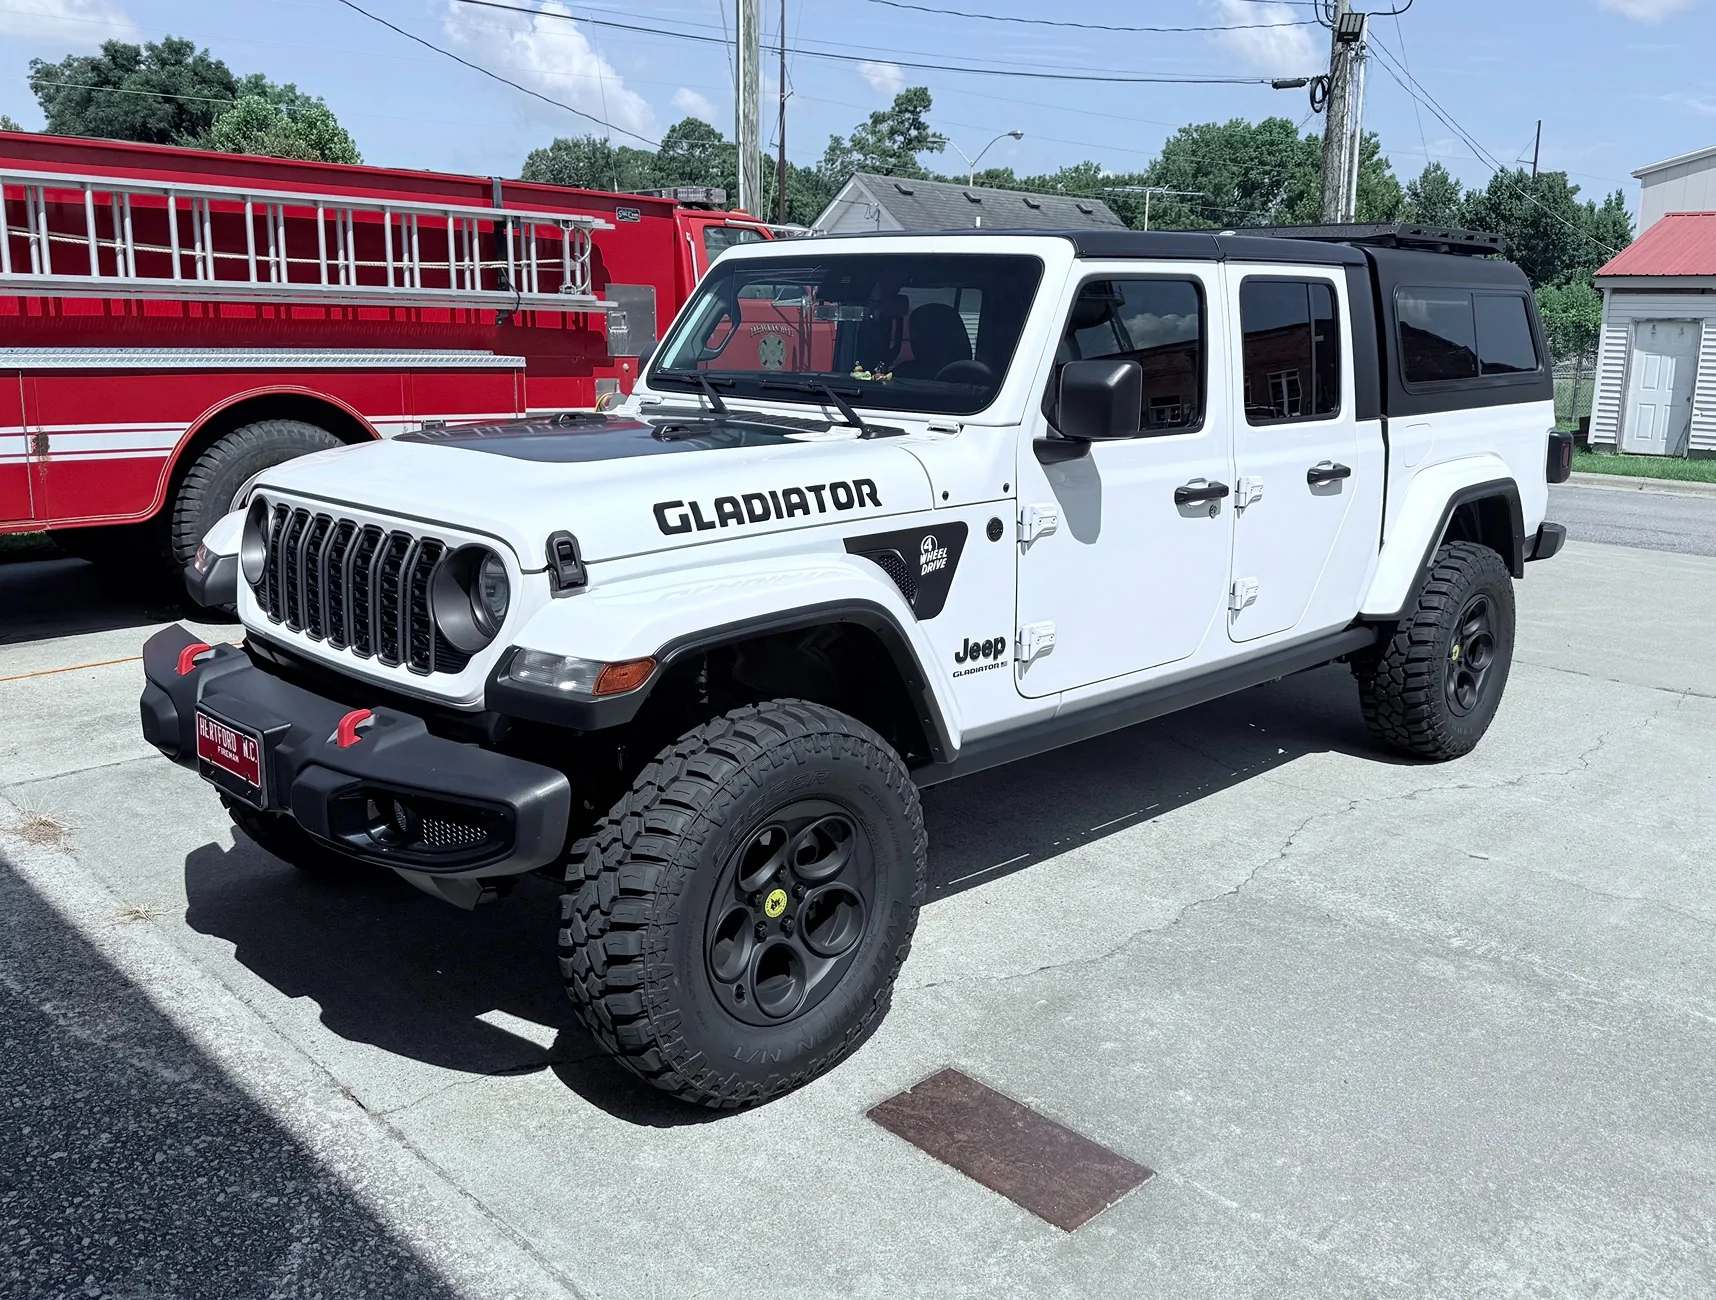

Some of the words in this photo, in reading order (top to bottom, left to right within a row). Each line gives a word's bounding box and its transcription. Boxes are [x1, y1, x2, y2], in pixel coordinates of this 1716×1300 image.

[749, 323, 794, 338] HERTFORD
[653, 478, 882, 536] GLADIATOR
[920, 547, 947, 565] WHEEL
[921, 558, 947, 576] DRIVE
[955, 636, 1006, 663] Jeep
[952, 662, 1000, 678] GLADIATOR
[200, 717, 236, 752] HERTFORD
[217, 746, 239, 763] FIREMAN
[728, 1045, 783, 1066] M/T
